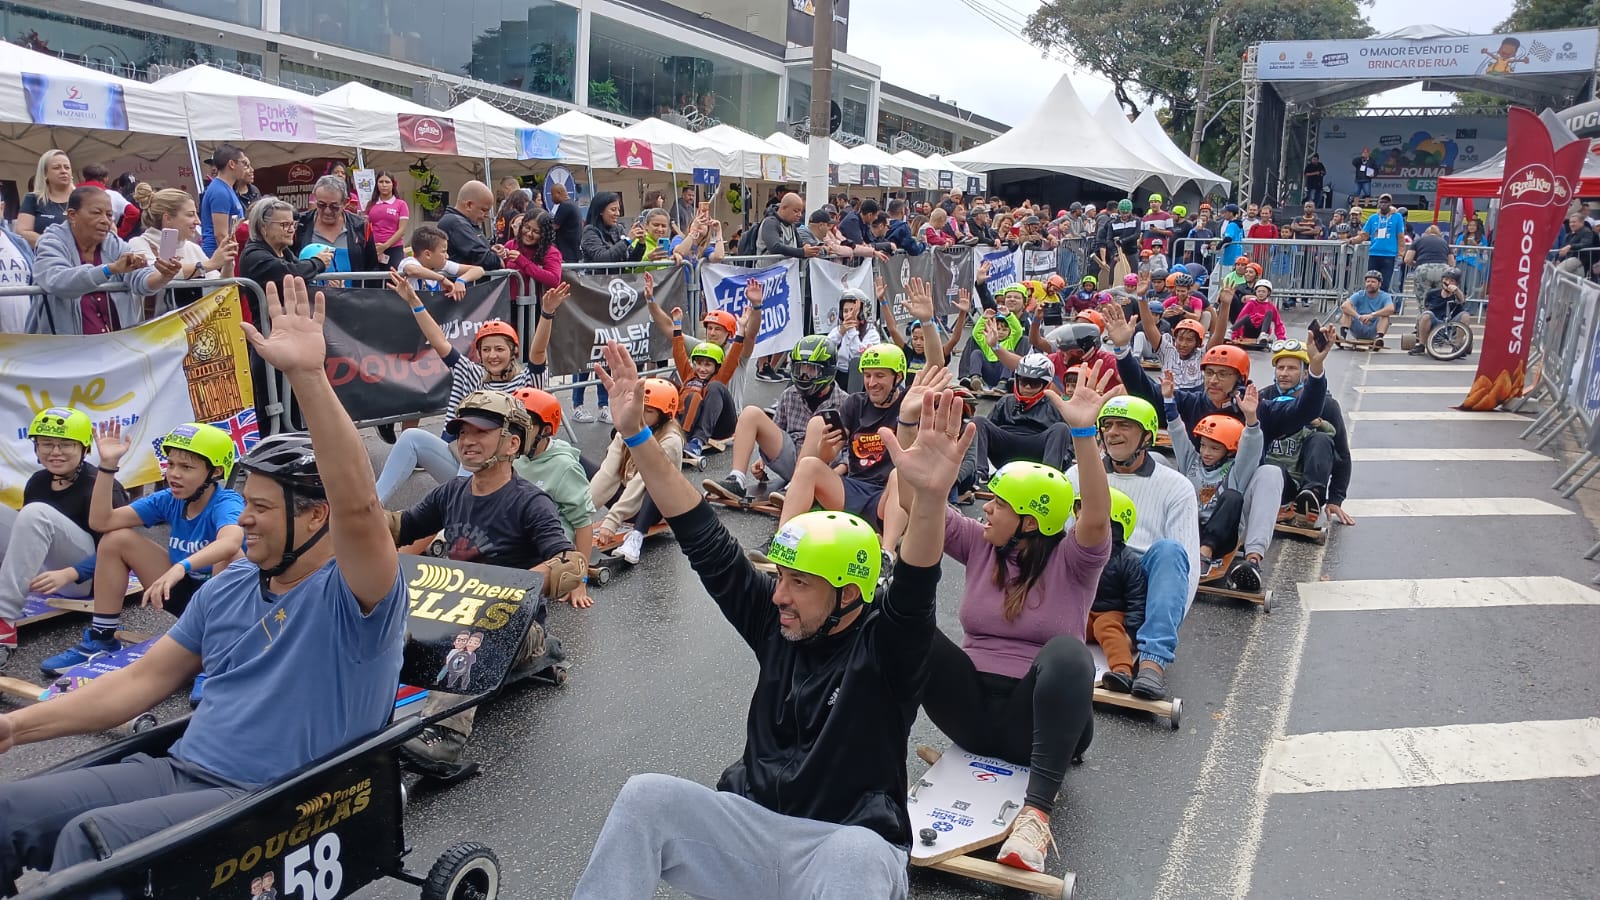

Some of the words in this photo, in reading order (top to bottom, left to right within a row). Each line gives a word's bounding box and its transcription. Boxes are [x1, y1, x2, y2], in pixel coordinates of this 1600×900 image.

[1360, 48, 1367, 56] O
[1371, 47, 1406, 56] MAIOR
[1408, 45, 1451, 55] EVENTO
[1454, 44, 1469, 53] DE
[1368, 60, 1415, 69] BRINCAR
[1417, 58, 1431, 68] DE
[1434, 57, 1458, 67] RUA
[256, 102, 287, 119] Pink
[258, 116, 298, 137] Party
[1415, 179, 1436, 190] FES
[1510, 178, 1536, 199] Bread
[1508, 219, 1535, 355] SALGADOS
[1267, 437, 1297, 457] AP
[458, 577, 527, 602] Pneus
[408, 587, 520, 630] LAS
[332, 777, 372, 801] Pneus
[210, 787, 372, 889] DOUGLAS
[284, 832, 343, 900] 58
